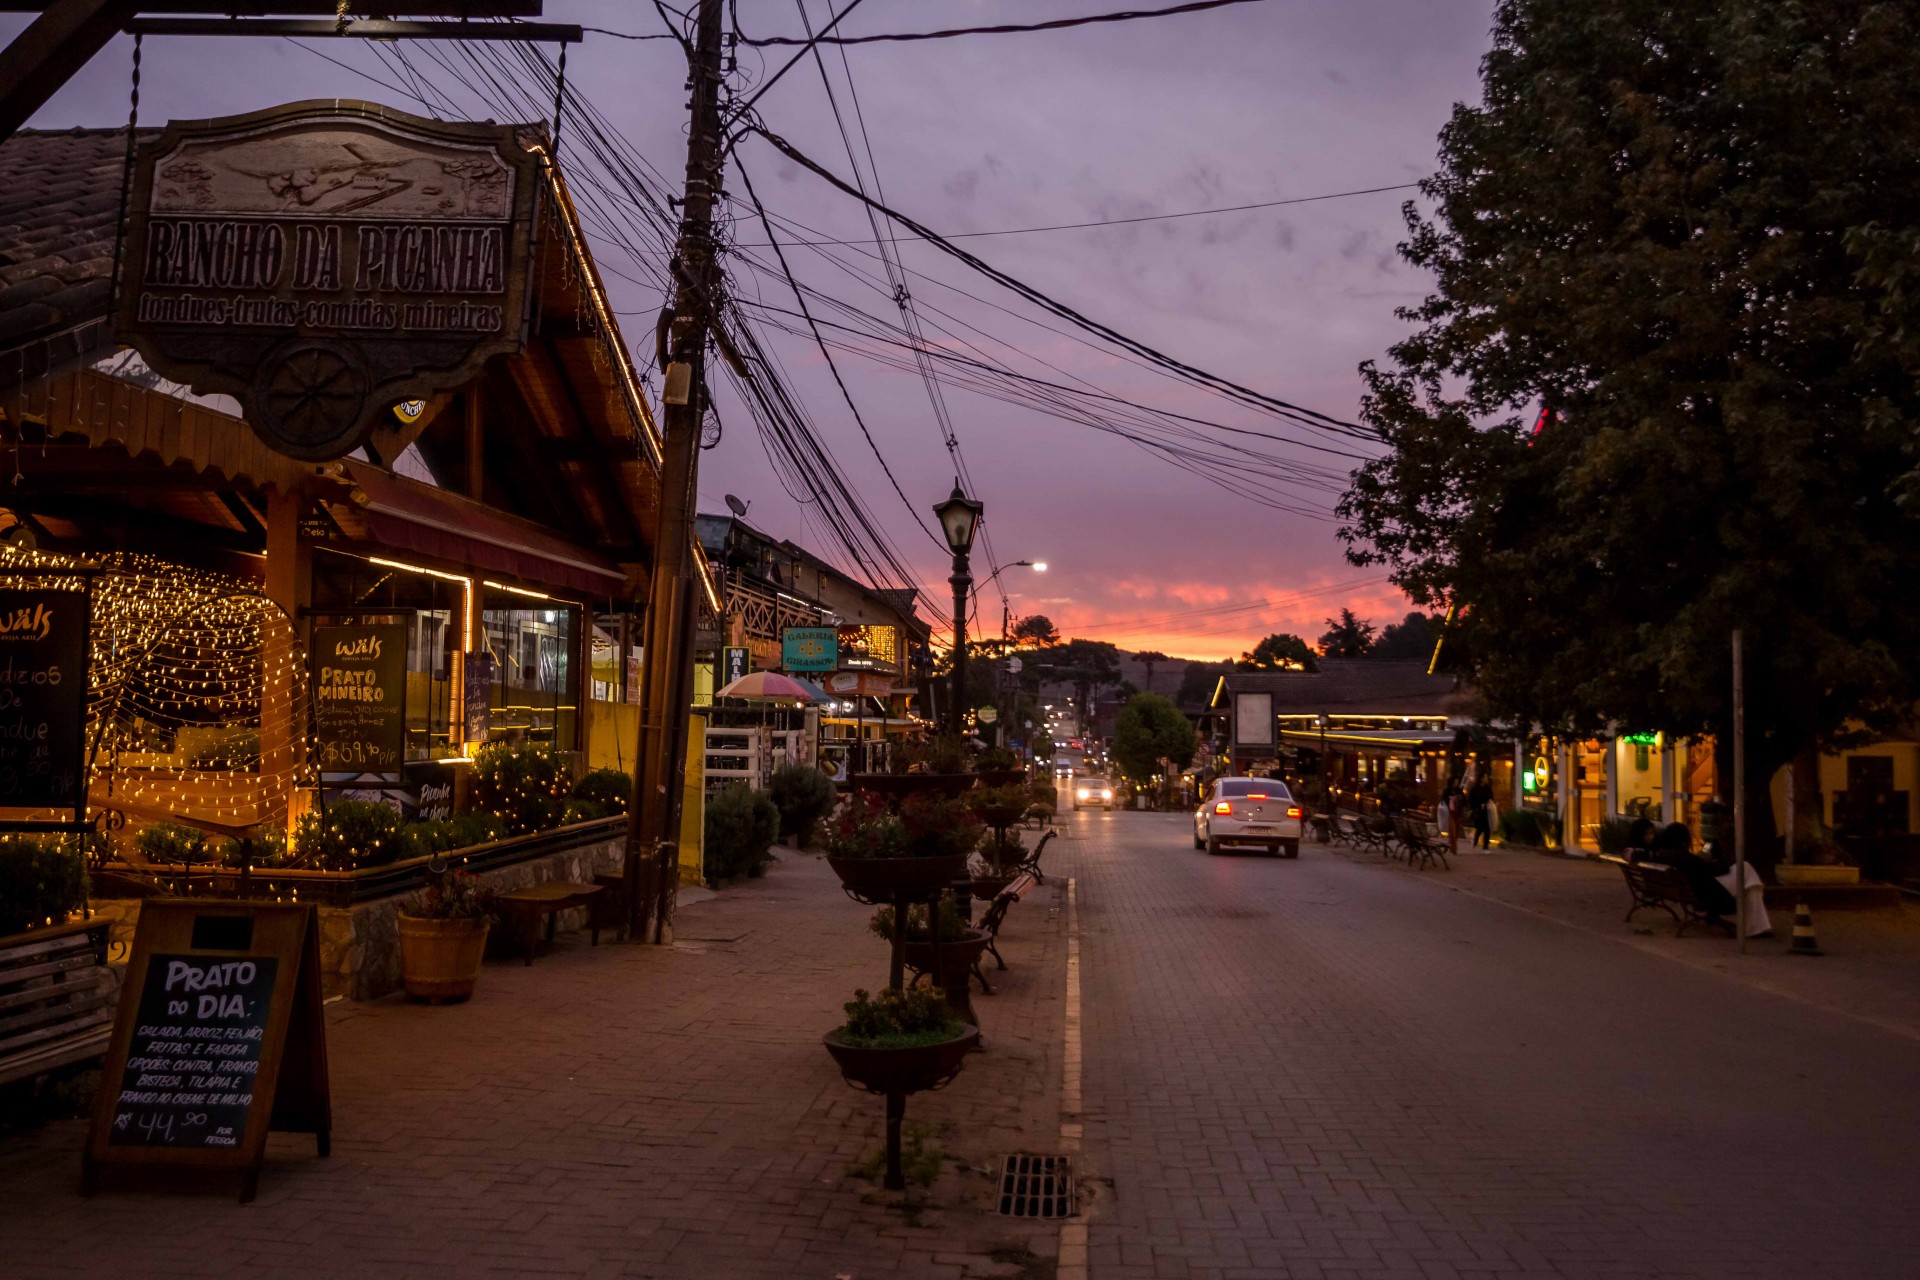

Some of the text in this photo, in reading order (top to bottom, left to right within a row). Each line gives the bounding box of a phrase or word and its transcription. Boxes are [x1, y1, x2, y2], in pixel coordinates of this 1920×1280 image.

[144, 220, 504, 293] RANCHO DA PICANHA
[402, 300, 502, 331] mineiras
[788, 632, 834, 641] GALERIA
[786, 657, 834, 667] GIRASSOL
[321, 667, 376, 686] PRATO
[319, 684, 384, 702] MINEIRO
[420, 782, 451, 804] Picanha
[165, 960, 256, 991] PRATO
[167, 1000, 189, 1016] DO
[137, 1025, 183, 1039] SALADA,
[183, 1026, 223, 1040] ARROZ,
[146, 1041, 249, 1056] FRITAS E FAROFA
[231, 1076, 243, 1089] E
[118, 1090, 253, 1106] FRANGO AO CREME DE MILHO
[215, 1126, 233, 1135] POR
[204, 1135, 236, 1145] PESSOA
